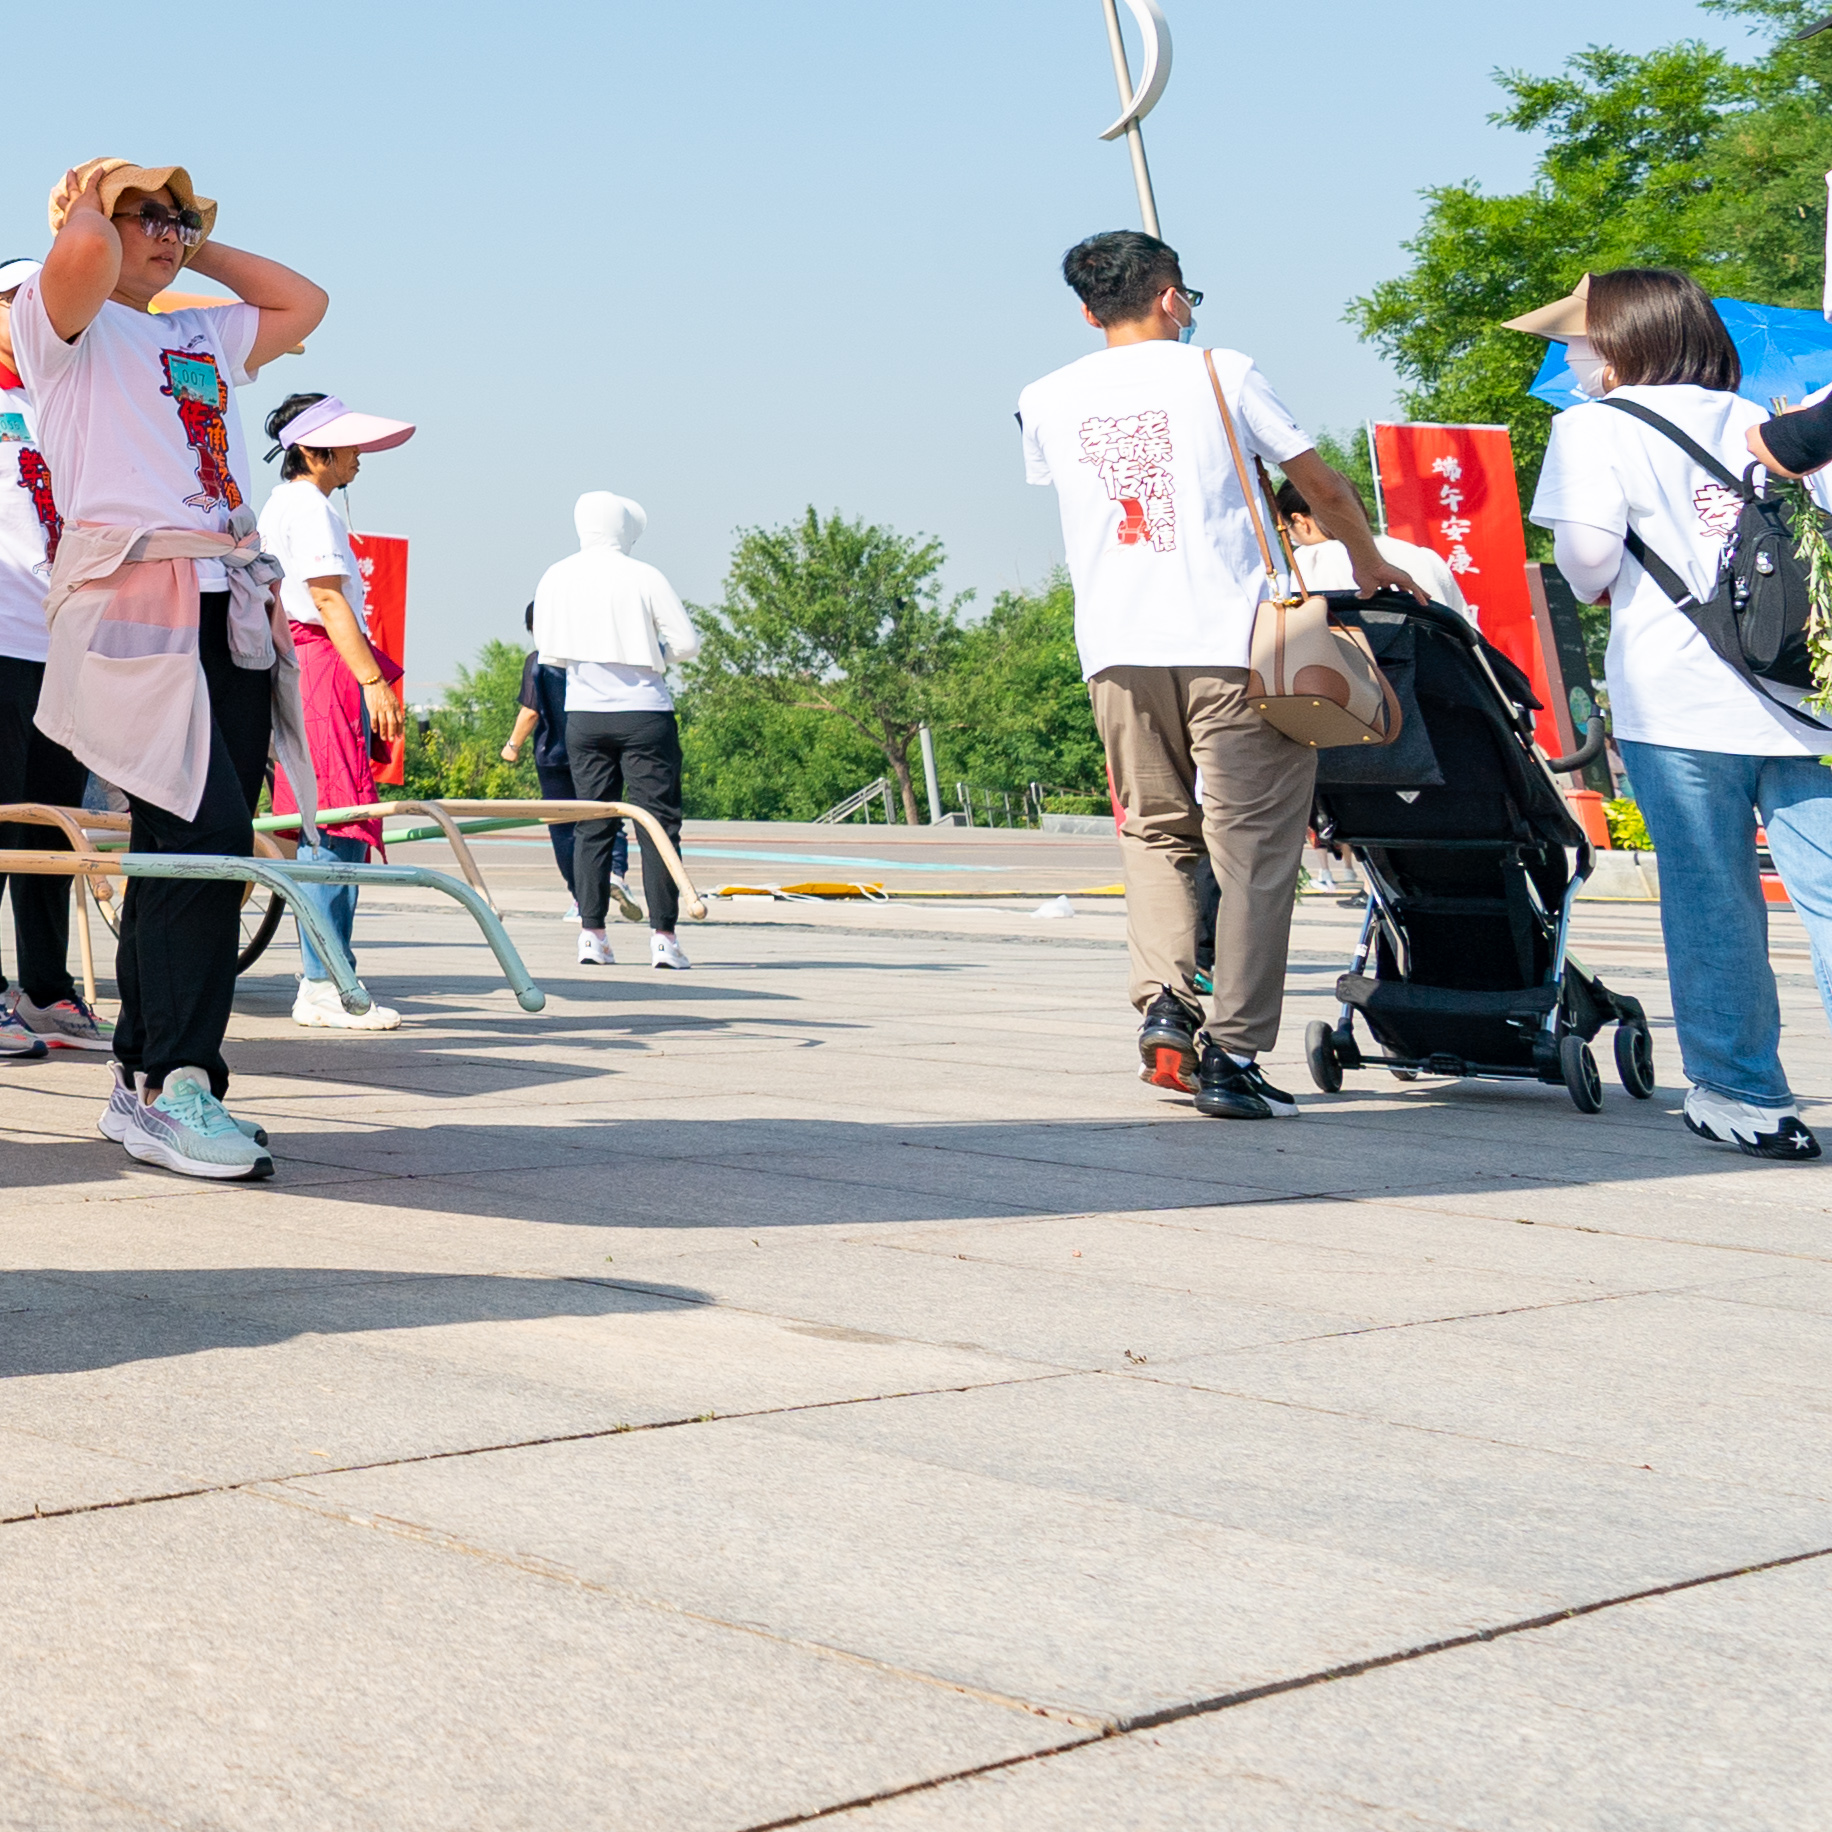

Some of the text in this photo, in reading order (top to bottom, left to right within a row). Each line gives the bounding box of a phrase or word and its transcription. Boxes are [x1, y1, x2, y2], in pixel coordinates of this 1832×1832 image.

[181, 368, 206, 387] 007
[1431, 455, 1480, 575] 端午安康
